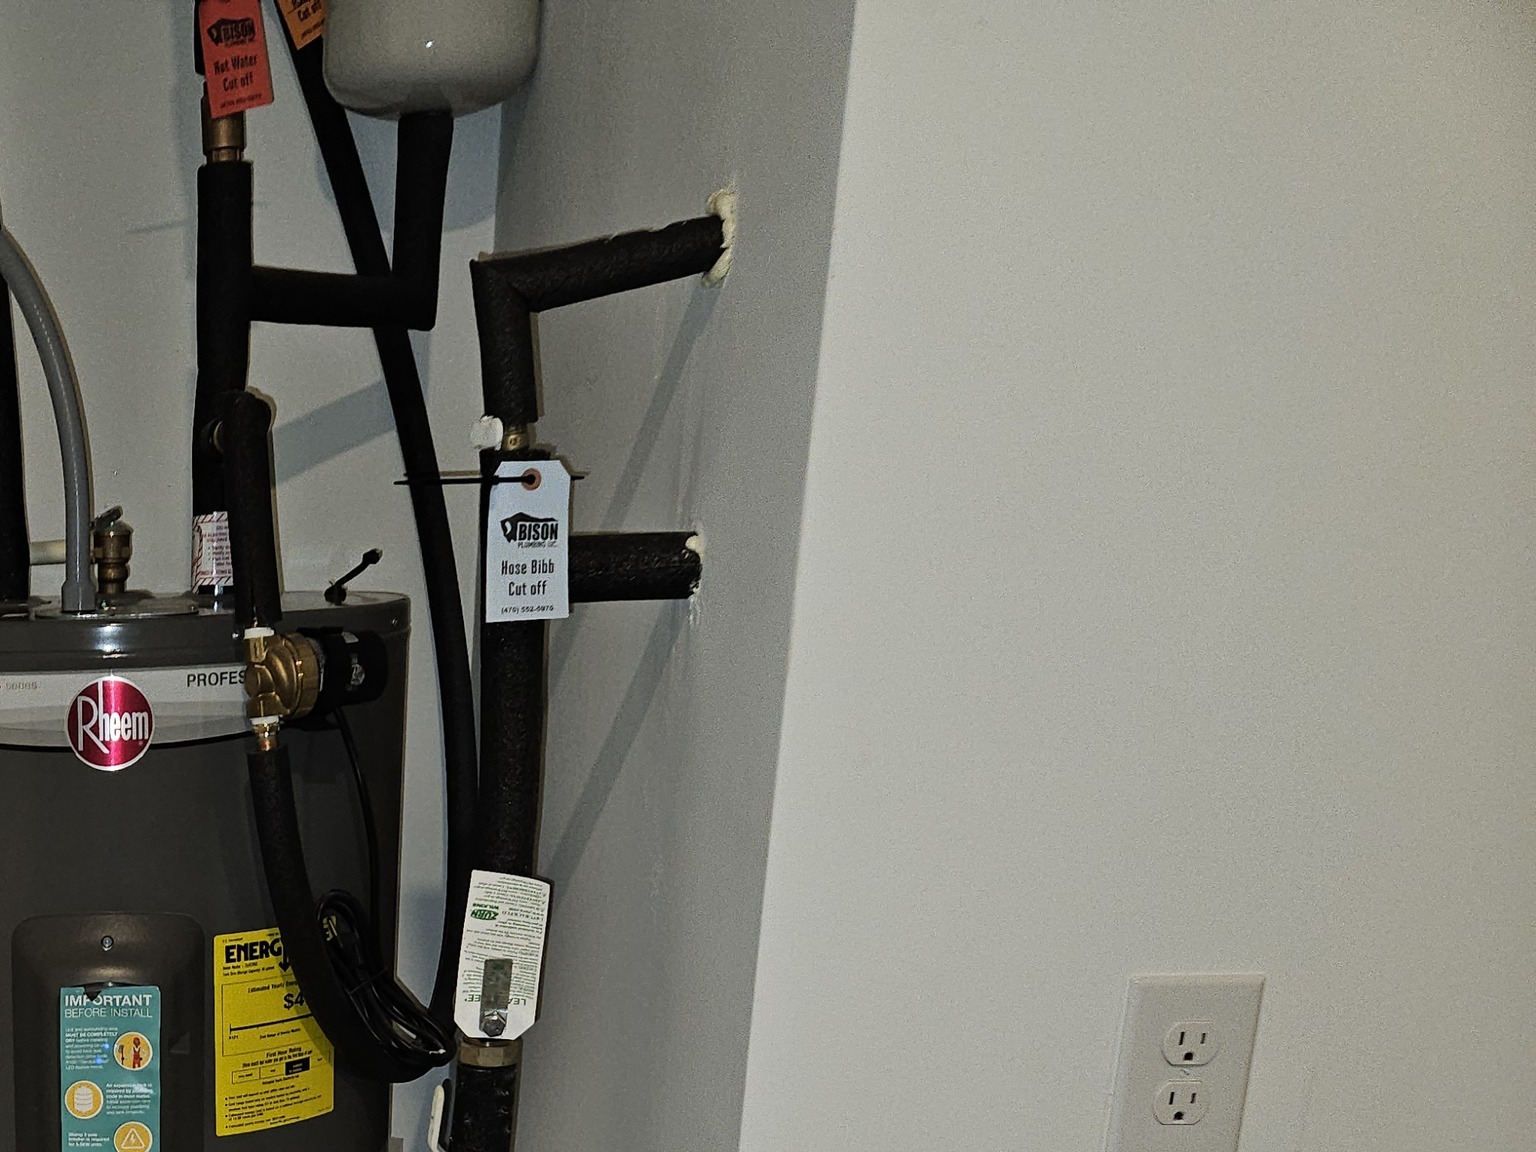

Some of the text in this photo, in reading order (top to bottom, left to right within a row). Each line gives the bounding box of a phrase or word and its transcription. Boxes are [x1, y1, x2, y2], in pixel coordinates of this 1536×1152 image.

[214, 54, 257, 75] Hot Water
[223, 72, 254, 91] Cut off
[518, 523, 558, 540] BISON
[501, 559, 554, 575] Hose Bibb
[508, 580, 547, 596] Cut off
[187, 671, 245, 687] PROFES
[77, 681, 149, 754] Rheem
[225, 938, 282, 963] ENERG
[284, 993, 305, 1010] $4
[64, 1008, 152, 1018] BEFORE INSTALL
